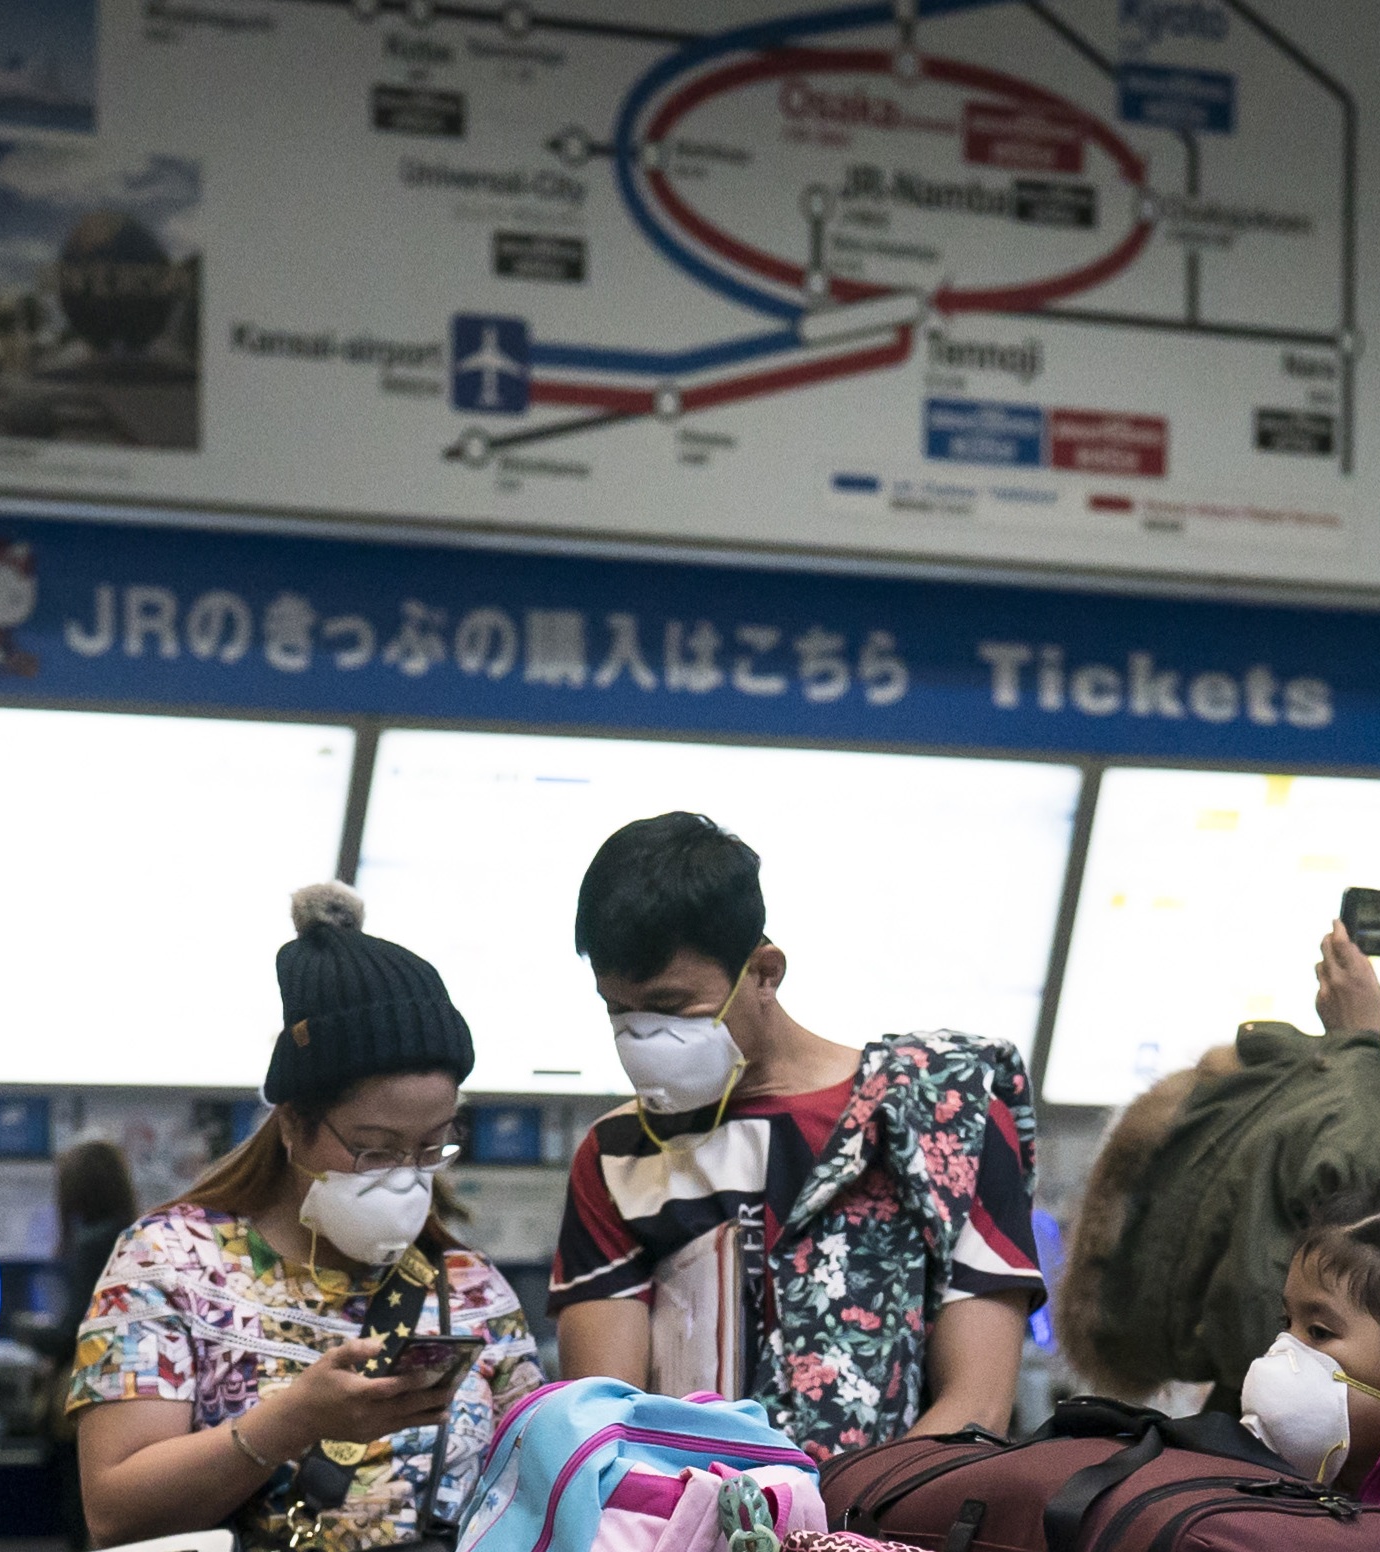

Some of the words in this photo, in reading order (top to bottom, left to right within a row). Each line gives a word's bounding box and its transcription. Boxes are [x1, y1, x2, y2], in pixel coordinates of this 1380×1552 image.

[780, 78, 902, 131] Osaka
[230, 320, 447, 371] Kansai-airport
[926, 330, 1044, 386] Tennoji
[63, 582, 911, 707] JRのきっぷの購入はこちら
[976, 637, 1336, 730] Tickets
